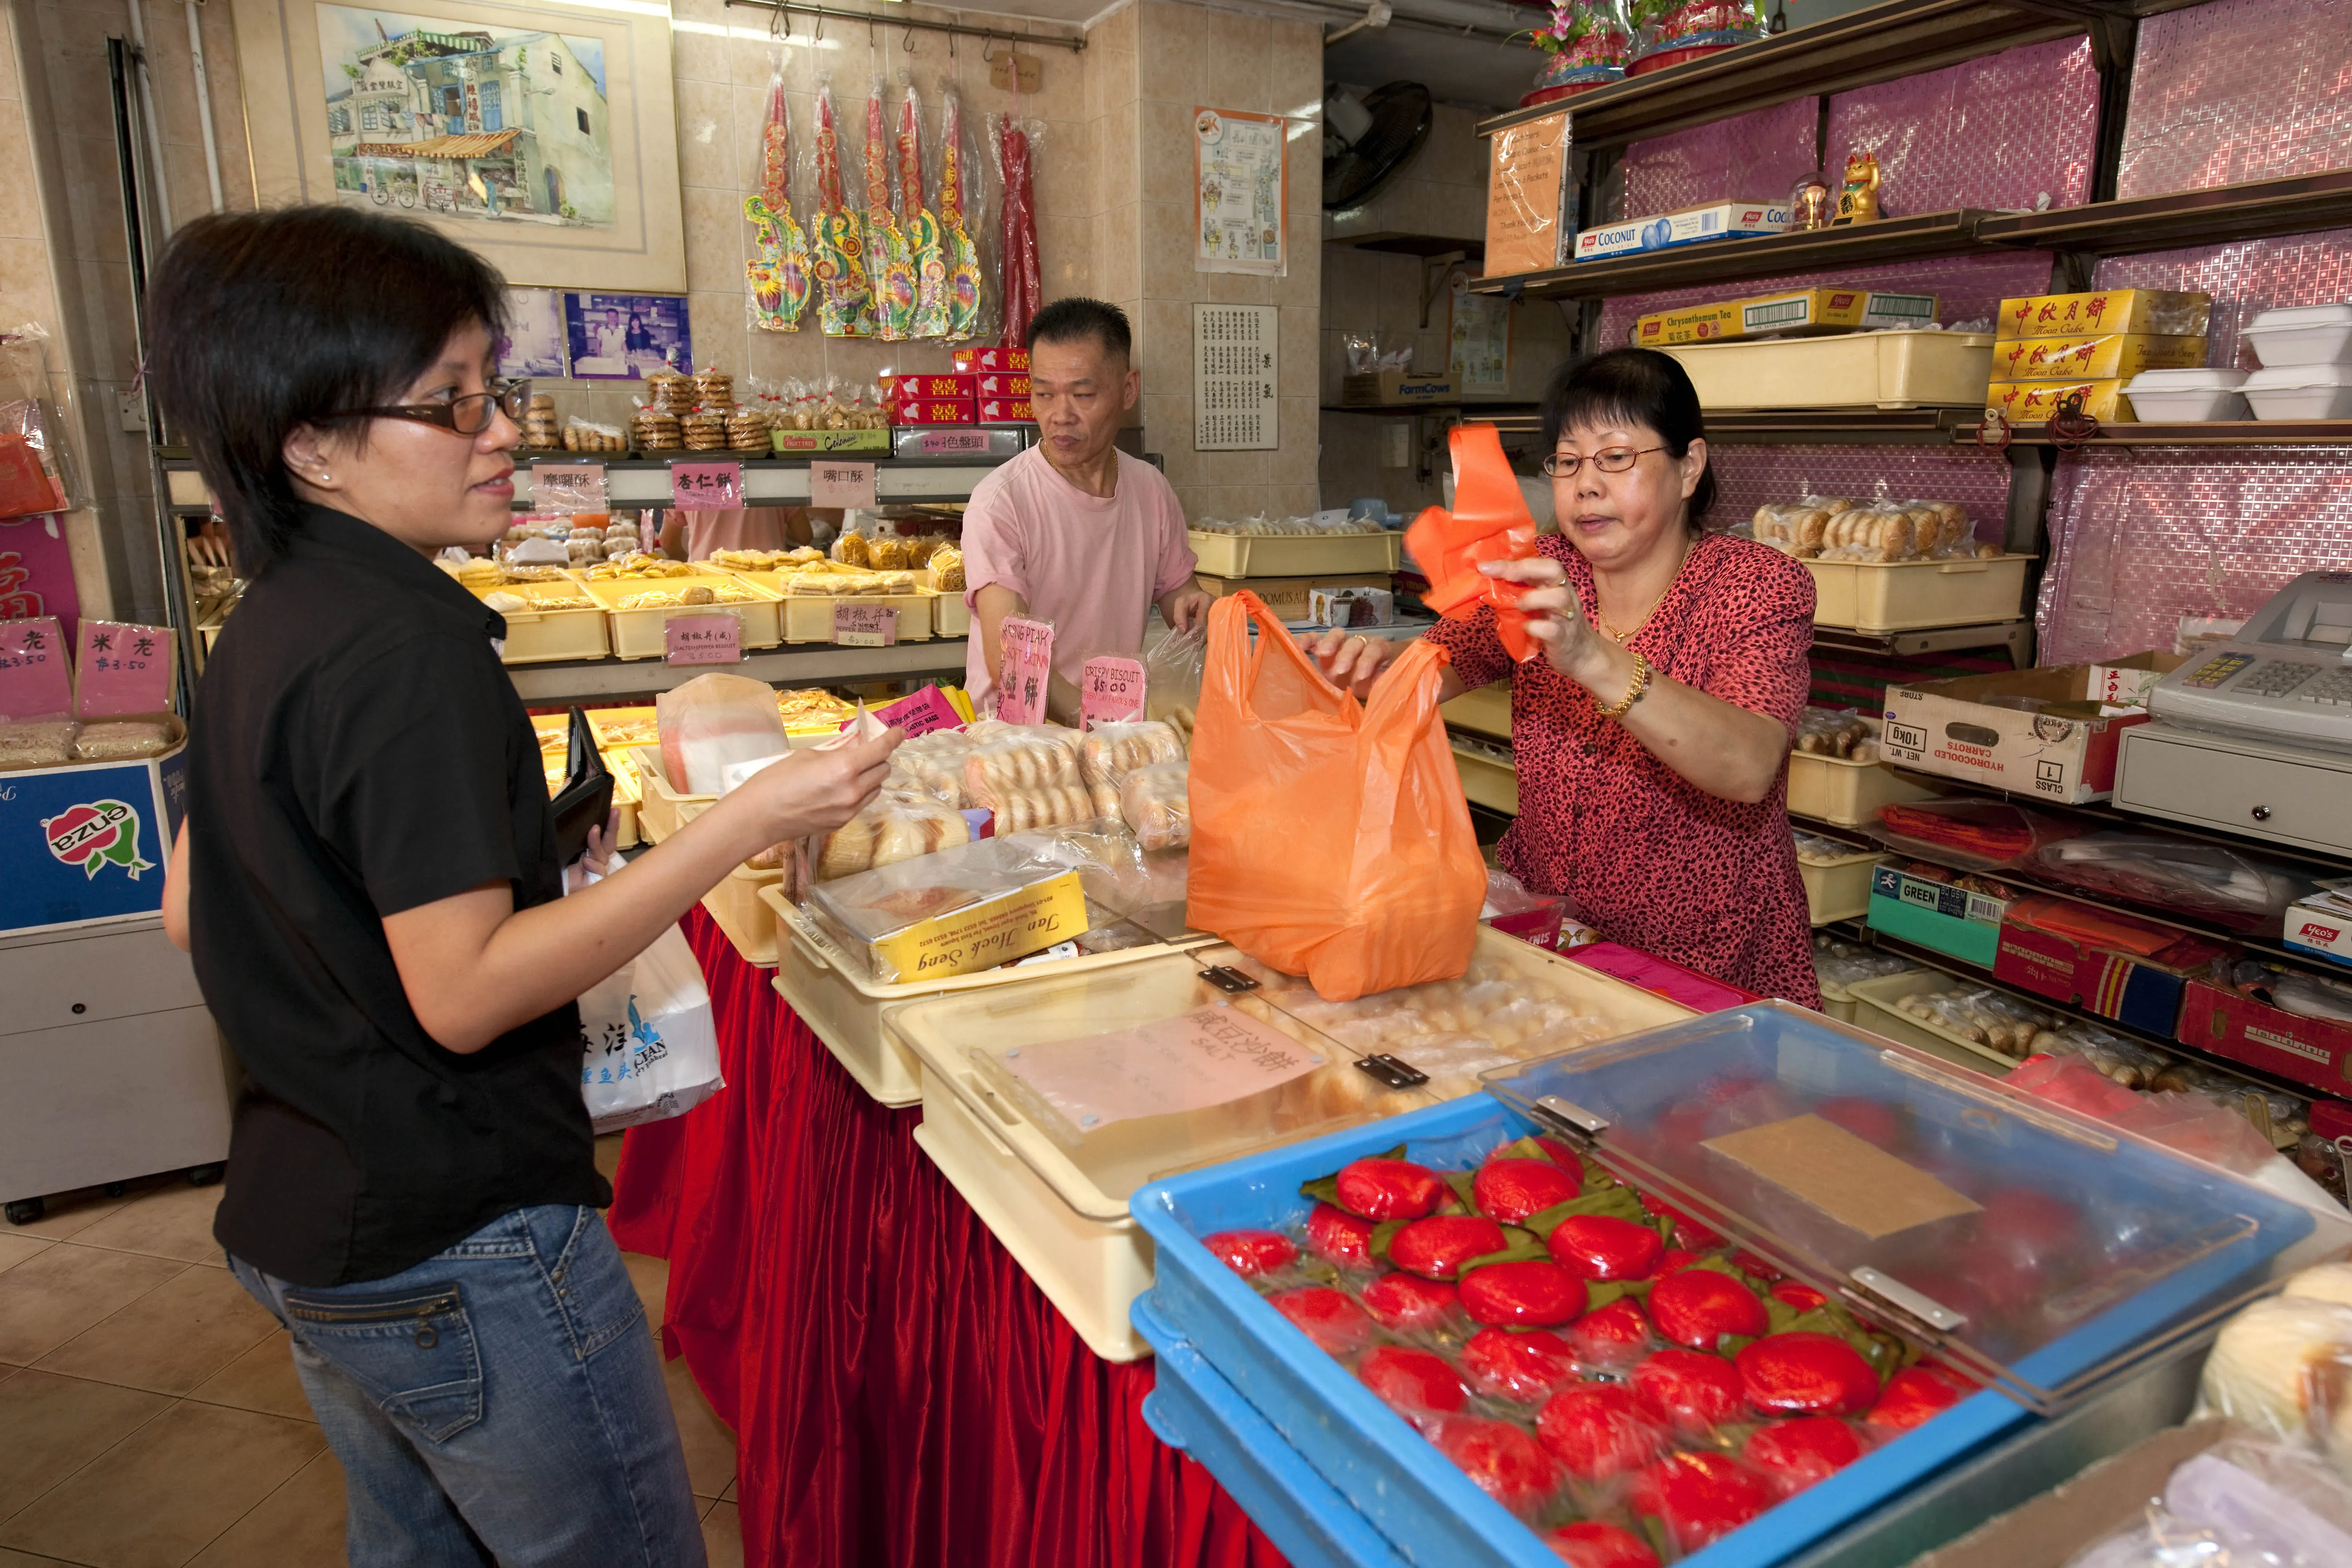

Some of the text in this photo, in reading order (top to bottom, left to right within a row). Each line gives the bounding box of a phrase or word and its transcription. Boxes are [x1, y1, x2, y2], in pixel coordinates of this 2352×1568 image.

[1526, 172, 1548, 182] Packets
[1667, 310, 1731, 327] Chrysanthemum Tea
[1668, 330, 1691, 341] 菊花茶
[2032, 323, 2084, 335] Moon Cake
[2022, 366, 2073, 377] Moon Cake
[2018, 410, 2043, 419] Moon
[678, 472, 733, 490] 杏仁餅
[824, 470, 864, 483] 嘴口酥
[1026, 627, 1049, 646] PIAH
[1006, 647, 1022, 659] SOFT
[96, 656, 146, 672] $3.50
[1085, 666, 1140, 683] CRISPY BISCUIT
[1084, 691, 1097, 700] EVERY
[1108, 695, 1127, 706] FAMOUS
[1129, 698, 1139, 708] ONE
[925, 714, 939, 724] BAGS
[1893, 726, 1918, 746] 10kg
[1889, 747, 1920, 761] NET. WT.
[1947, 742, 1992, 758] CARROTS
[1934, 750, 2004, 772] HYDROCOOLED
[2047, 766, 2053, 777] 1
[2036, 780, 2063, 794] CLASS
[51, 806, 128, 851] enza
[1904, 885, 1936, 904] GREEN
[1951, 888, 1965, 899] GSM
[1009, 901, 1036, 915] Singapore
[964, 923, 977, 932] 6533
[917, 913, 1059, 971] Tan Hock Seng
[934, 934, 947, 942] 6533
[940, 935, 960, 947] Square
[961, 931, 973, 940] East
[919, 939, 933, 947] 6572
[1191, 1037, 1236, 1061] SALT
